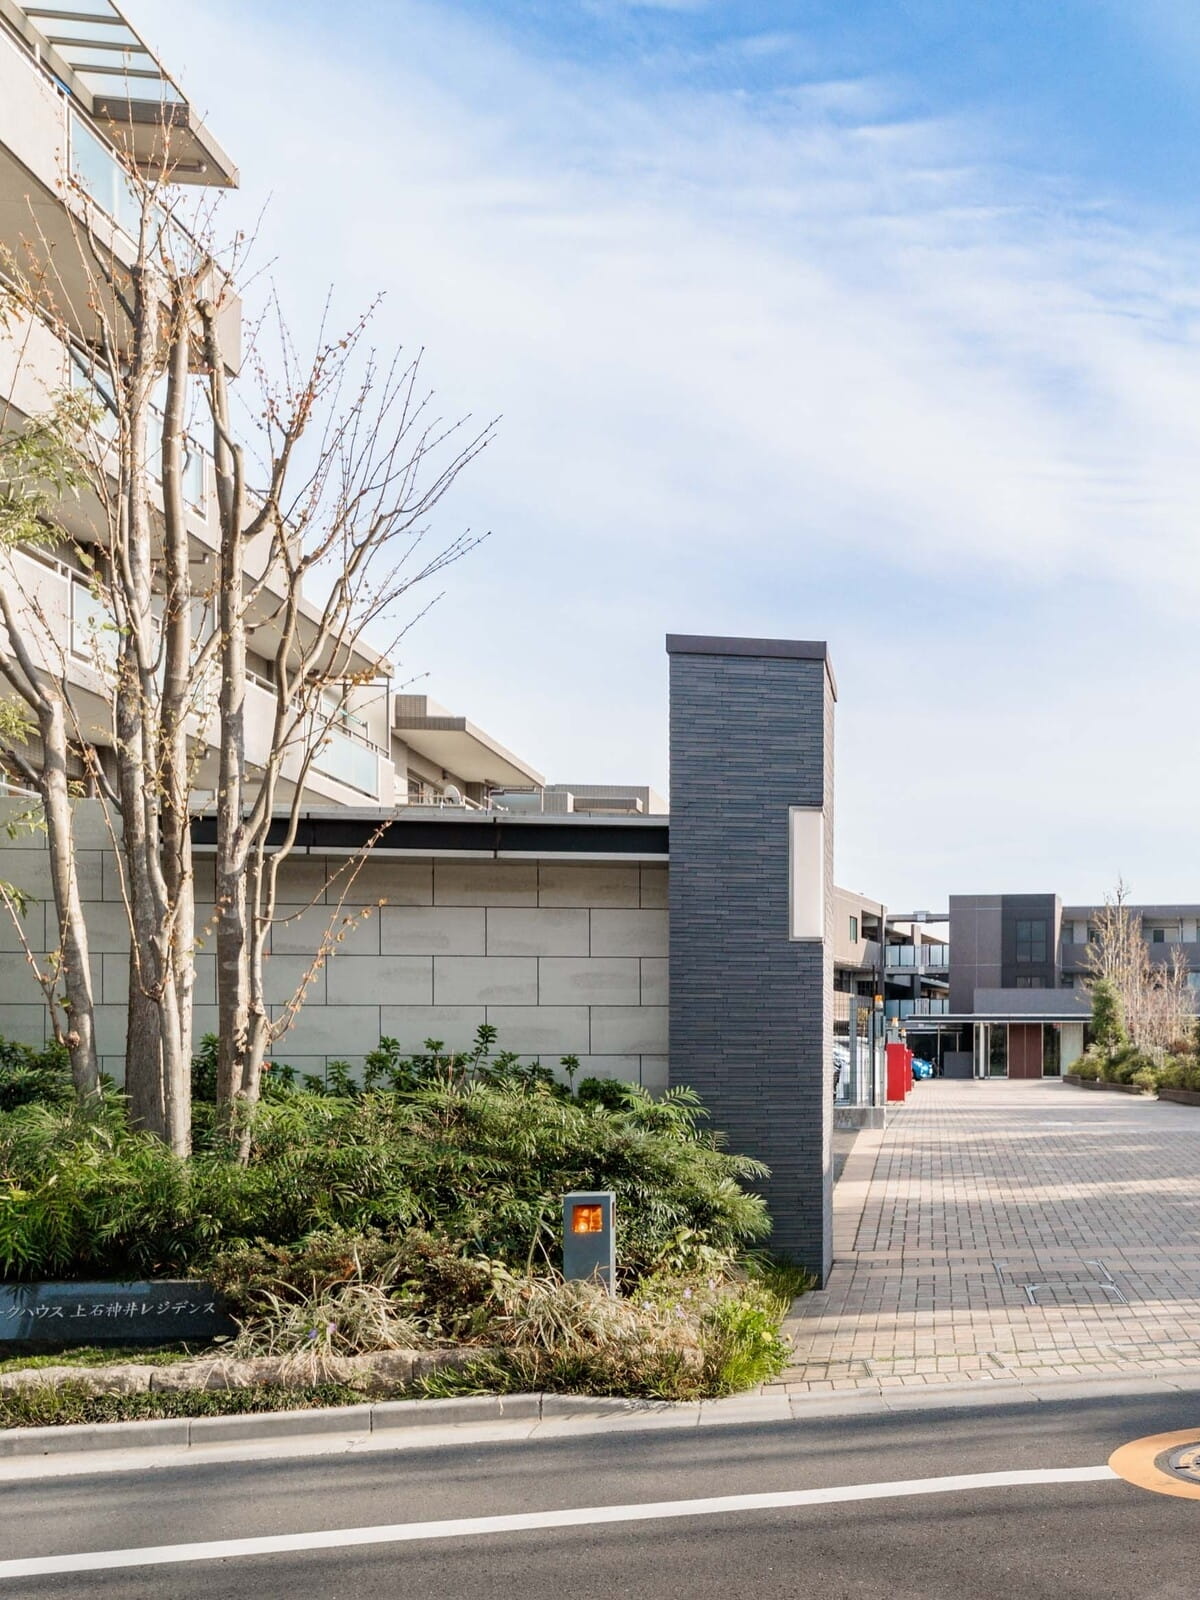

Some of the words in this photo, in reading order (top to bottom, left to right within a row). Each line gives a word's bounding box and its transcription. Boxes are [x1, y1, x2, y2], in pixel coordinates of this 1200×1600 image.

[69, 1300, 216, 1319] 上石神井レジデンス
